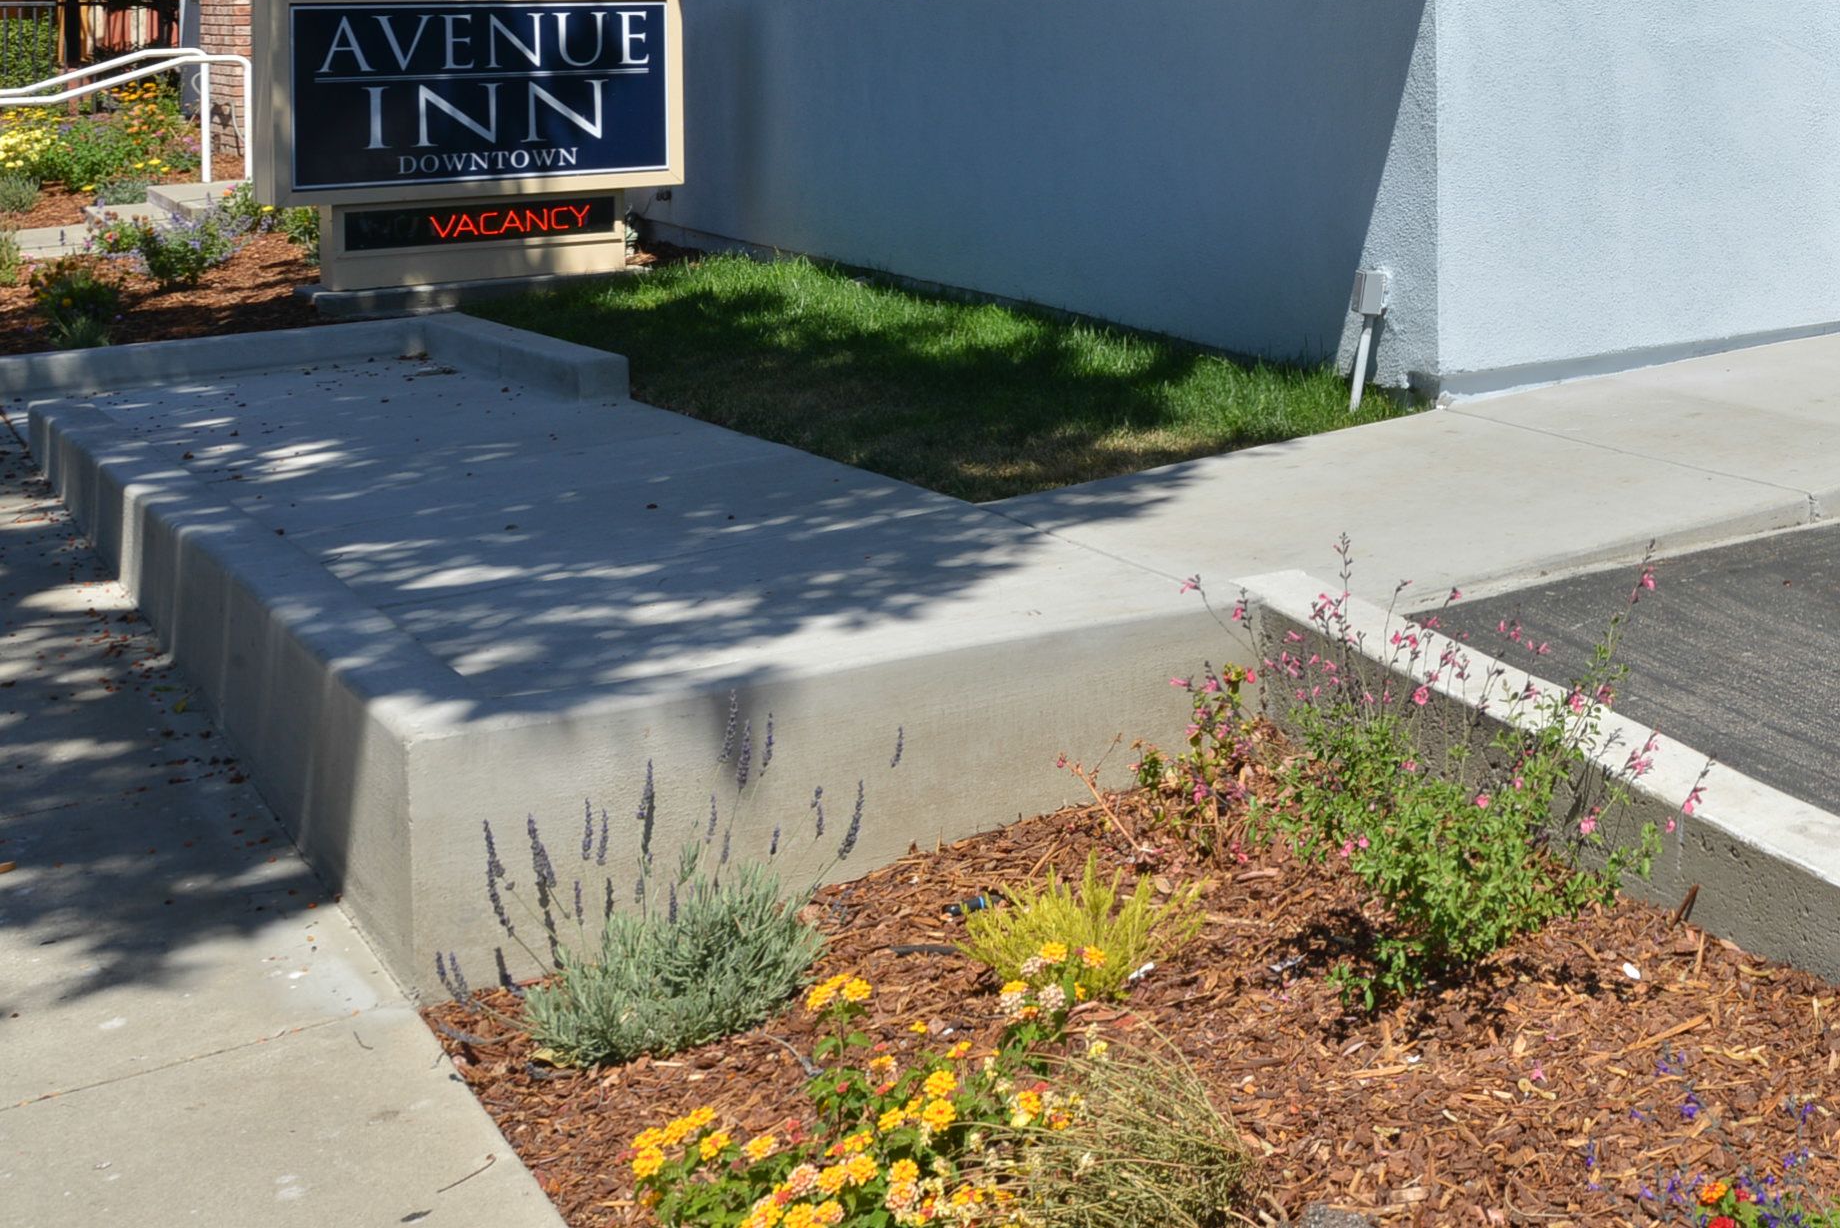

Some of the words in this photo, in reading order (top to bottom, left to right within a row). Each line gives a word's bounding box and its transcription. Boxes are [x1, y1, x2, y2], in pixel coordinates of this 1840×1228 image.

[319, 11, 650, 73] AVENUE
[363, 78, 608, 150] INN
[398, 146, 578, 175] DOWNTOWN
[428, 204, 592, 239] VACANCY
